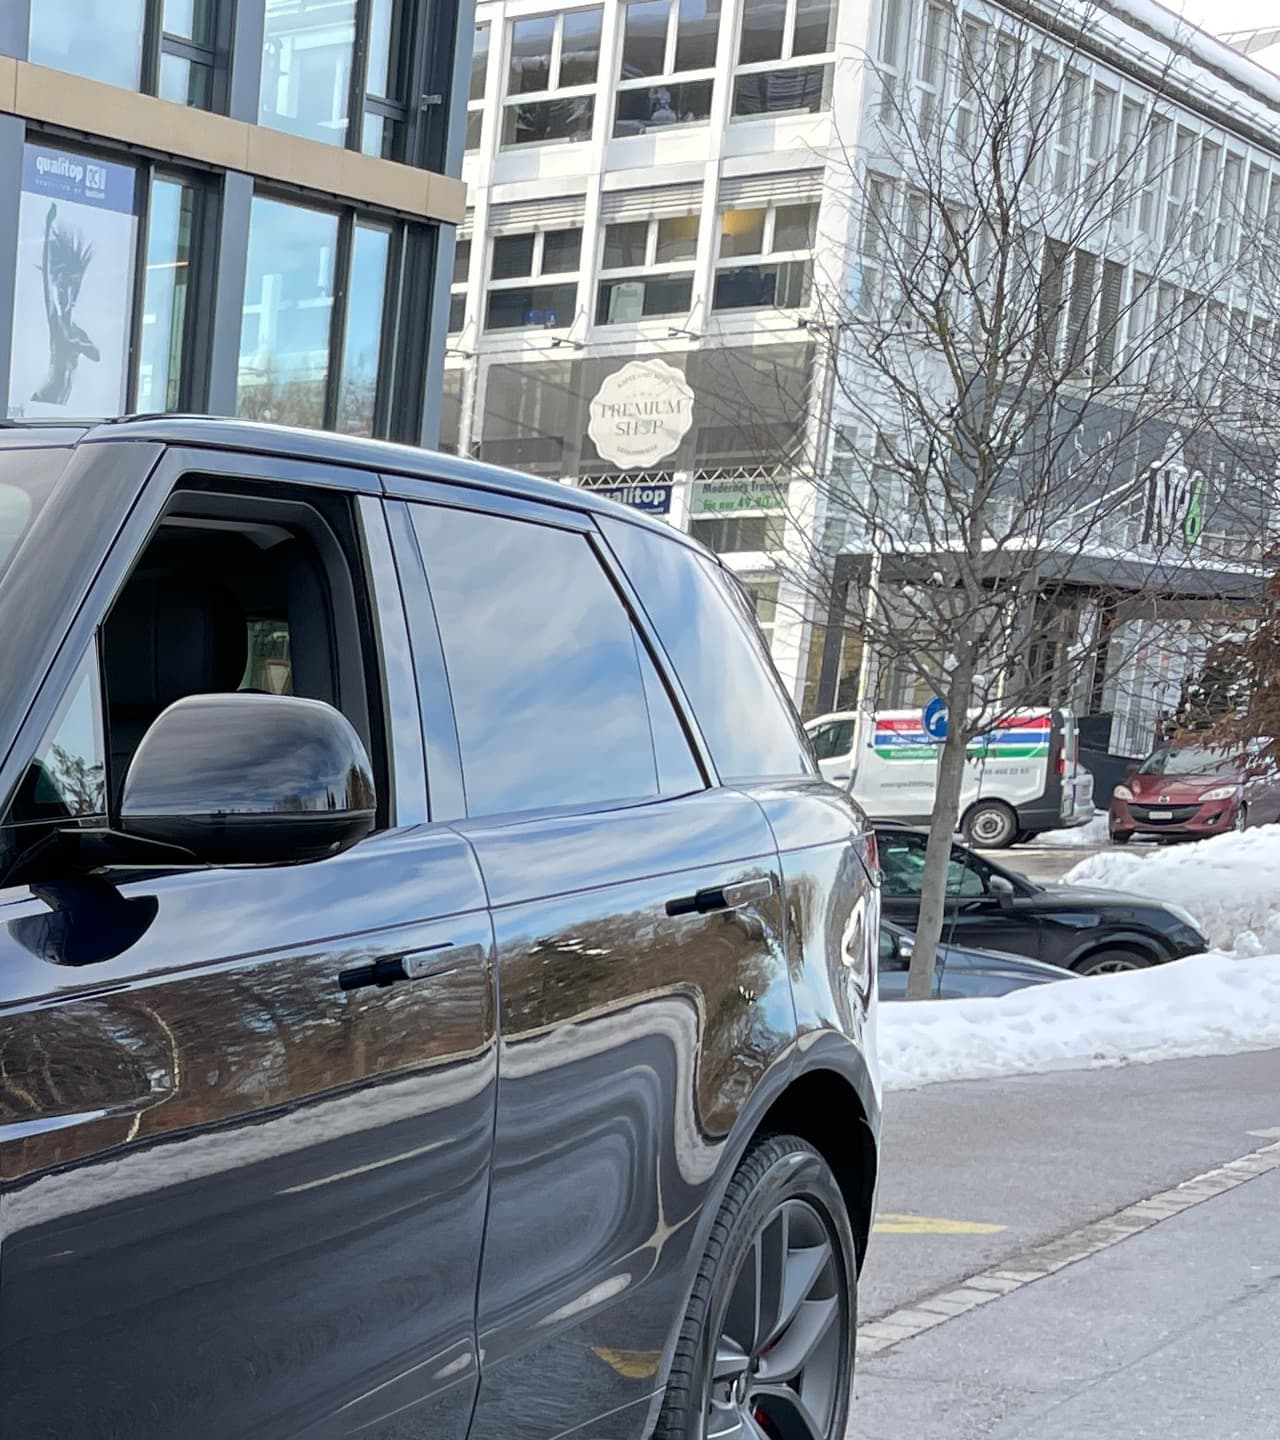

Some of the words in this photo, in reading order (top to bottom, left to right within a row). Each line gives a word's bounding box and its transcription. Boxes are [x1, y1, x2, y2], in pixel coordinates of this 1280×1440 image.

[35, 156, 84, 183] qualitop
[600, 400, 682, 419] PREMIUM
[615, 420, 664, 437] SHOP
